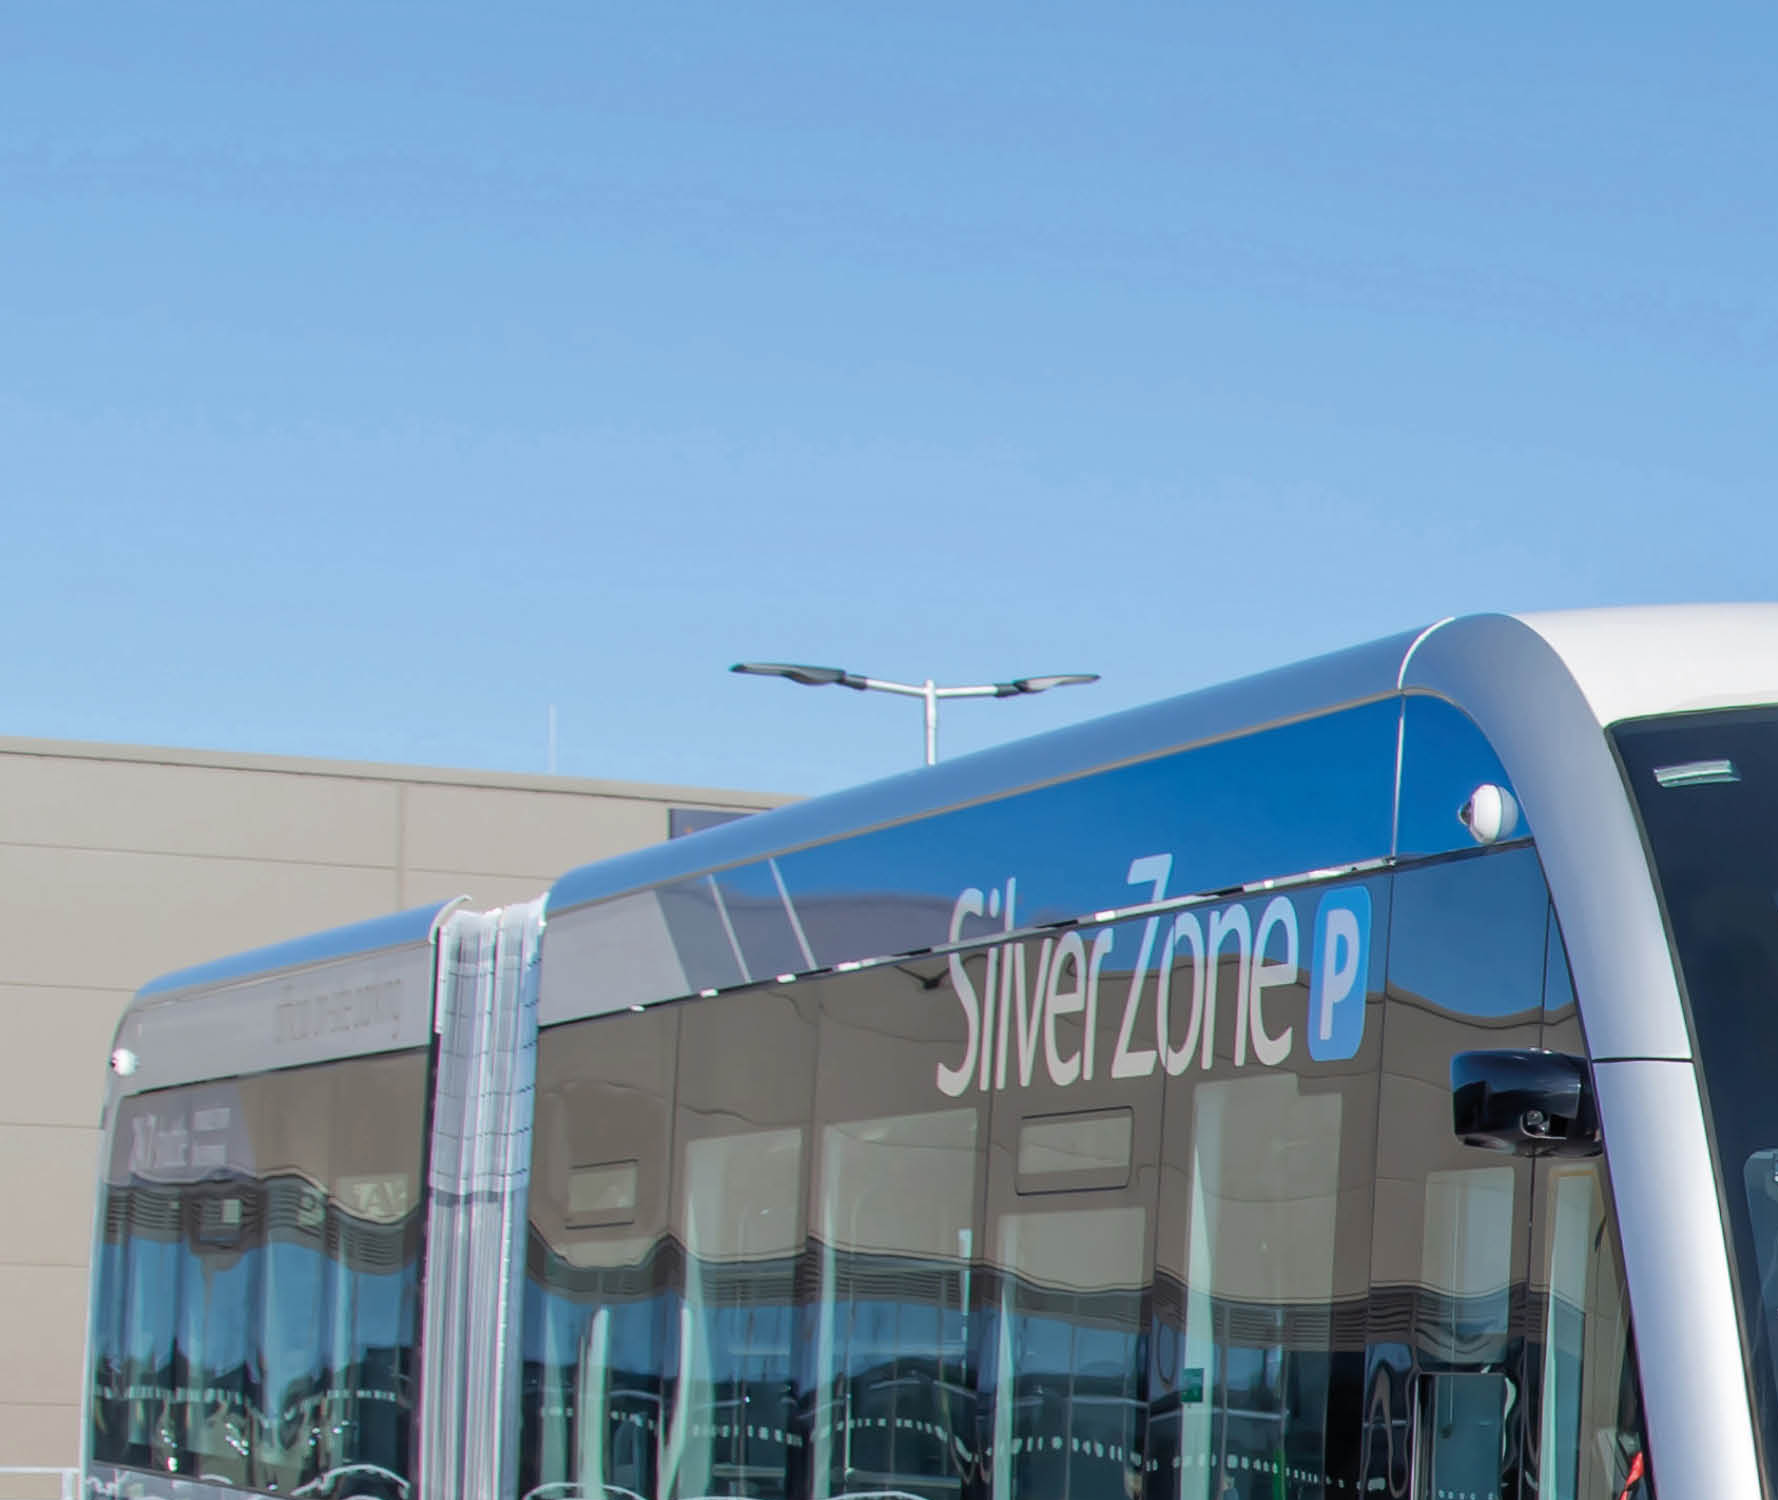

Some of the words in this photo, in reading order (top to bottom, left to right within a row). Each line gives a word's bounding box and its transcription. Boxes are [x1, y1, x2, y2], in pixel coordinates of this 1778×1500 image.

[937, 877, 1113, 1098] Silver
[1111, 853, 1299, 1080] Zone
[1319, 909, 1359, 1041] P
